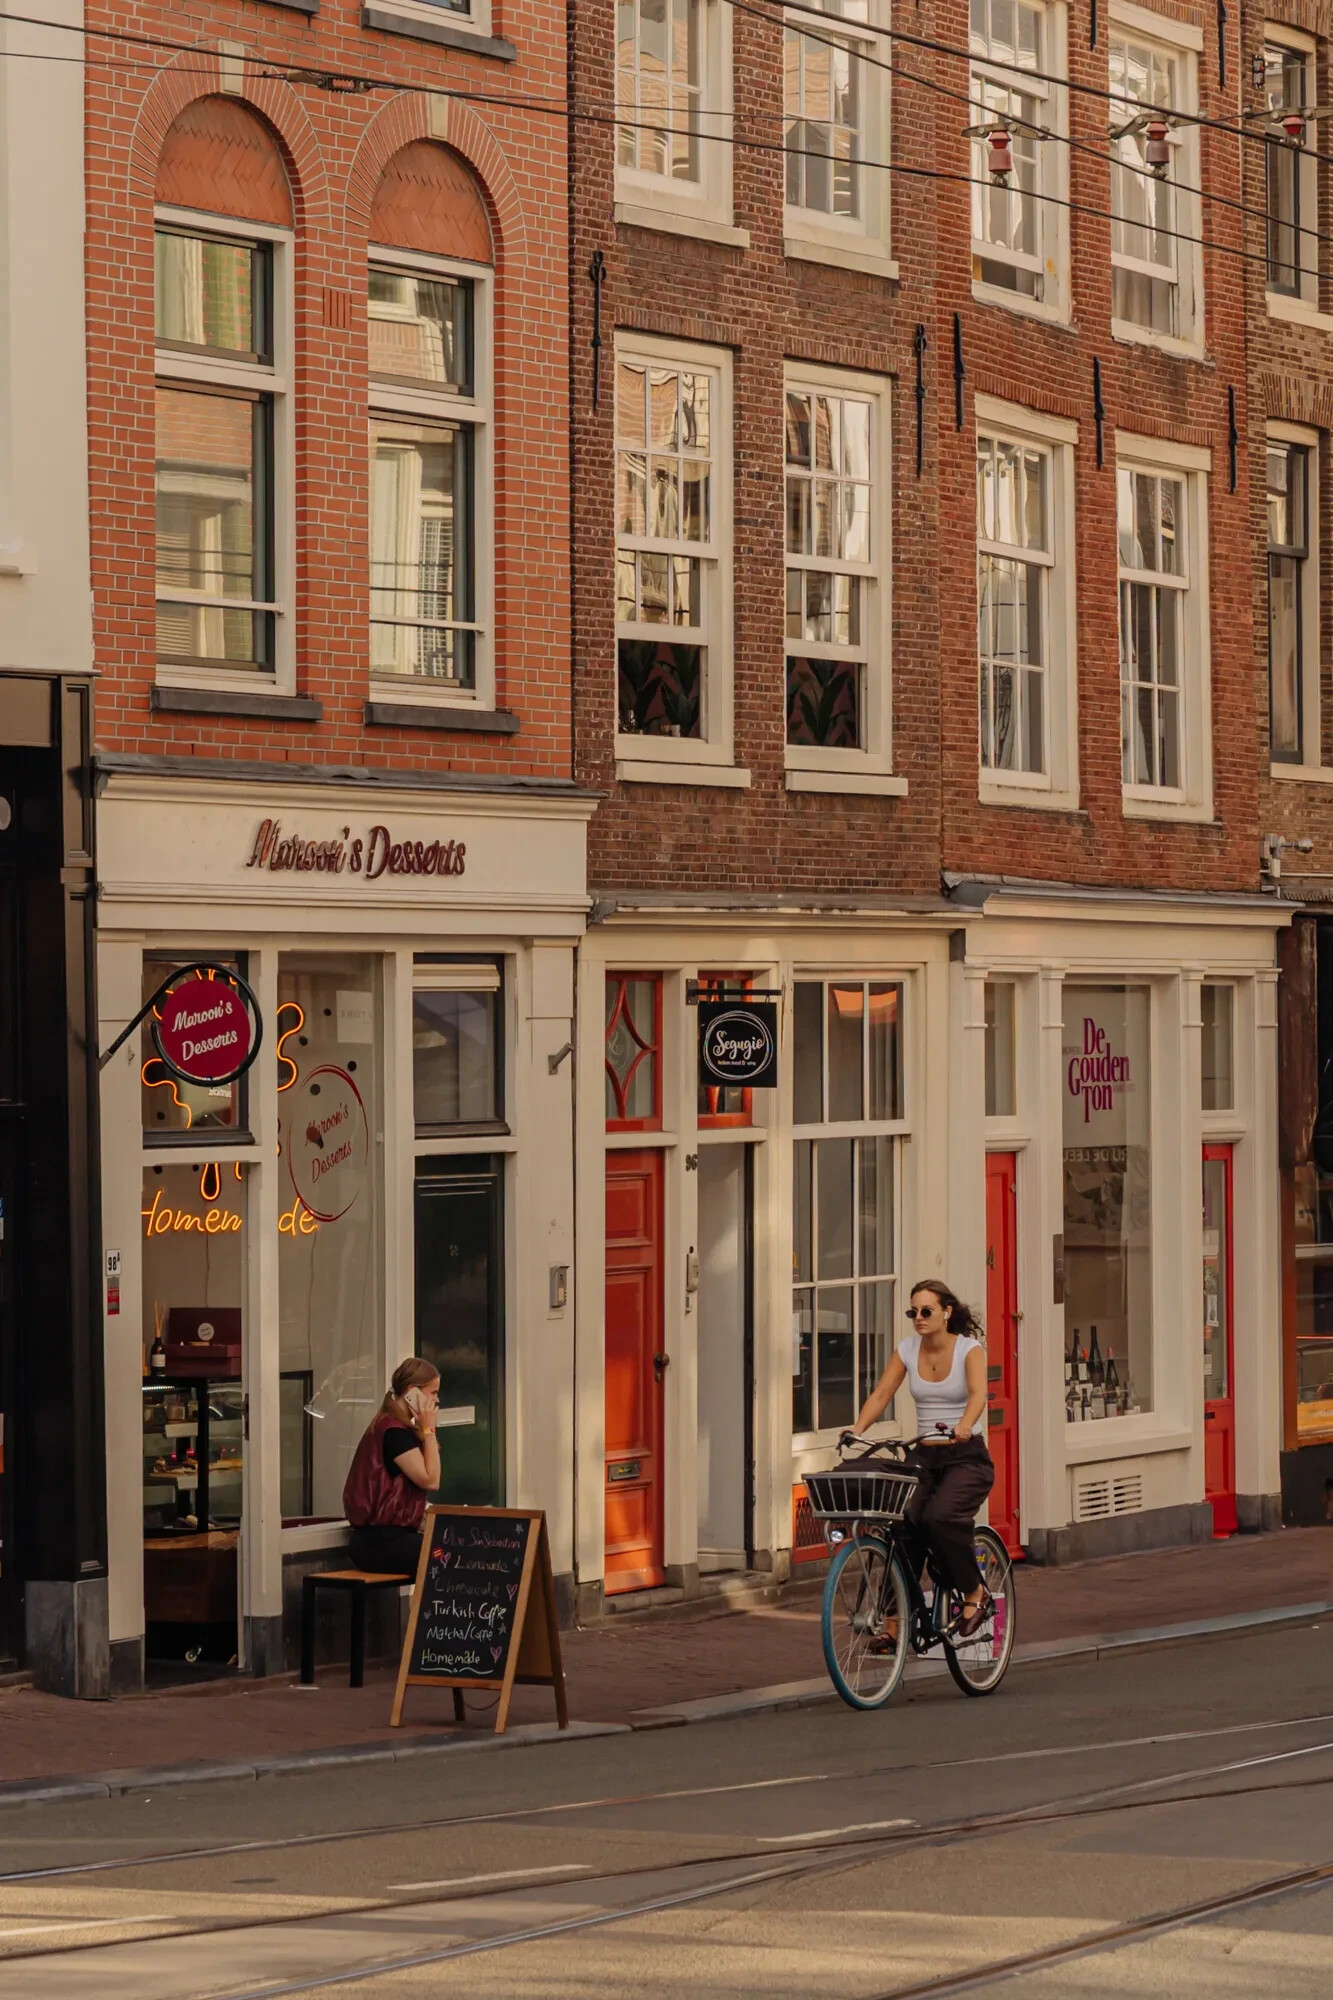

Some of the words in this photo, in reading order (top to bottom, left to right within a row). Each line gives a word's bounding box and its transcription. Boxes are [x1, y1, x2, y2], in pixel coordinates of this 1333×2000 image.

[246, 819, 363, 873] Maroon's
[366, 825, 466, 879] Desserts
[171, 999, 233, 1032] Maroon's
[181, 1030, 238, 1061] Desserts
[712, 1030, 764, 1060] Segugio
[1083, 1017, 1106, 1055] De
[1068, 1043, 1131, 1096] Gouden
[1081, 1083, 1114, 1123] Ton
[311, 1140, 352, 1184] Desserts
[685, 1153, 698, 1172] 96
[140, 1190, 319, 1236] Homende
[432, 1599, 475, 1618] Turkish
[421, 1648, 481, 1666] Homemade
